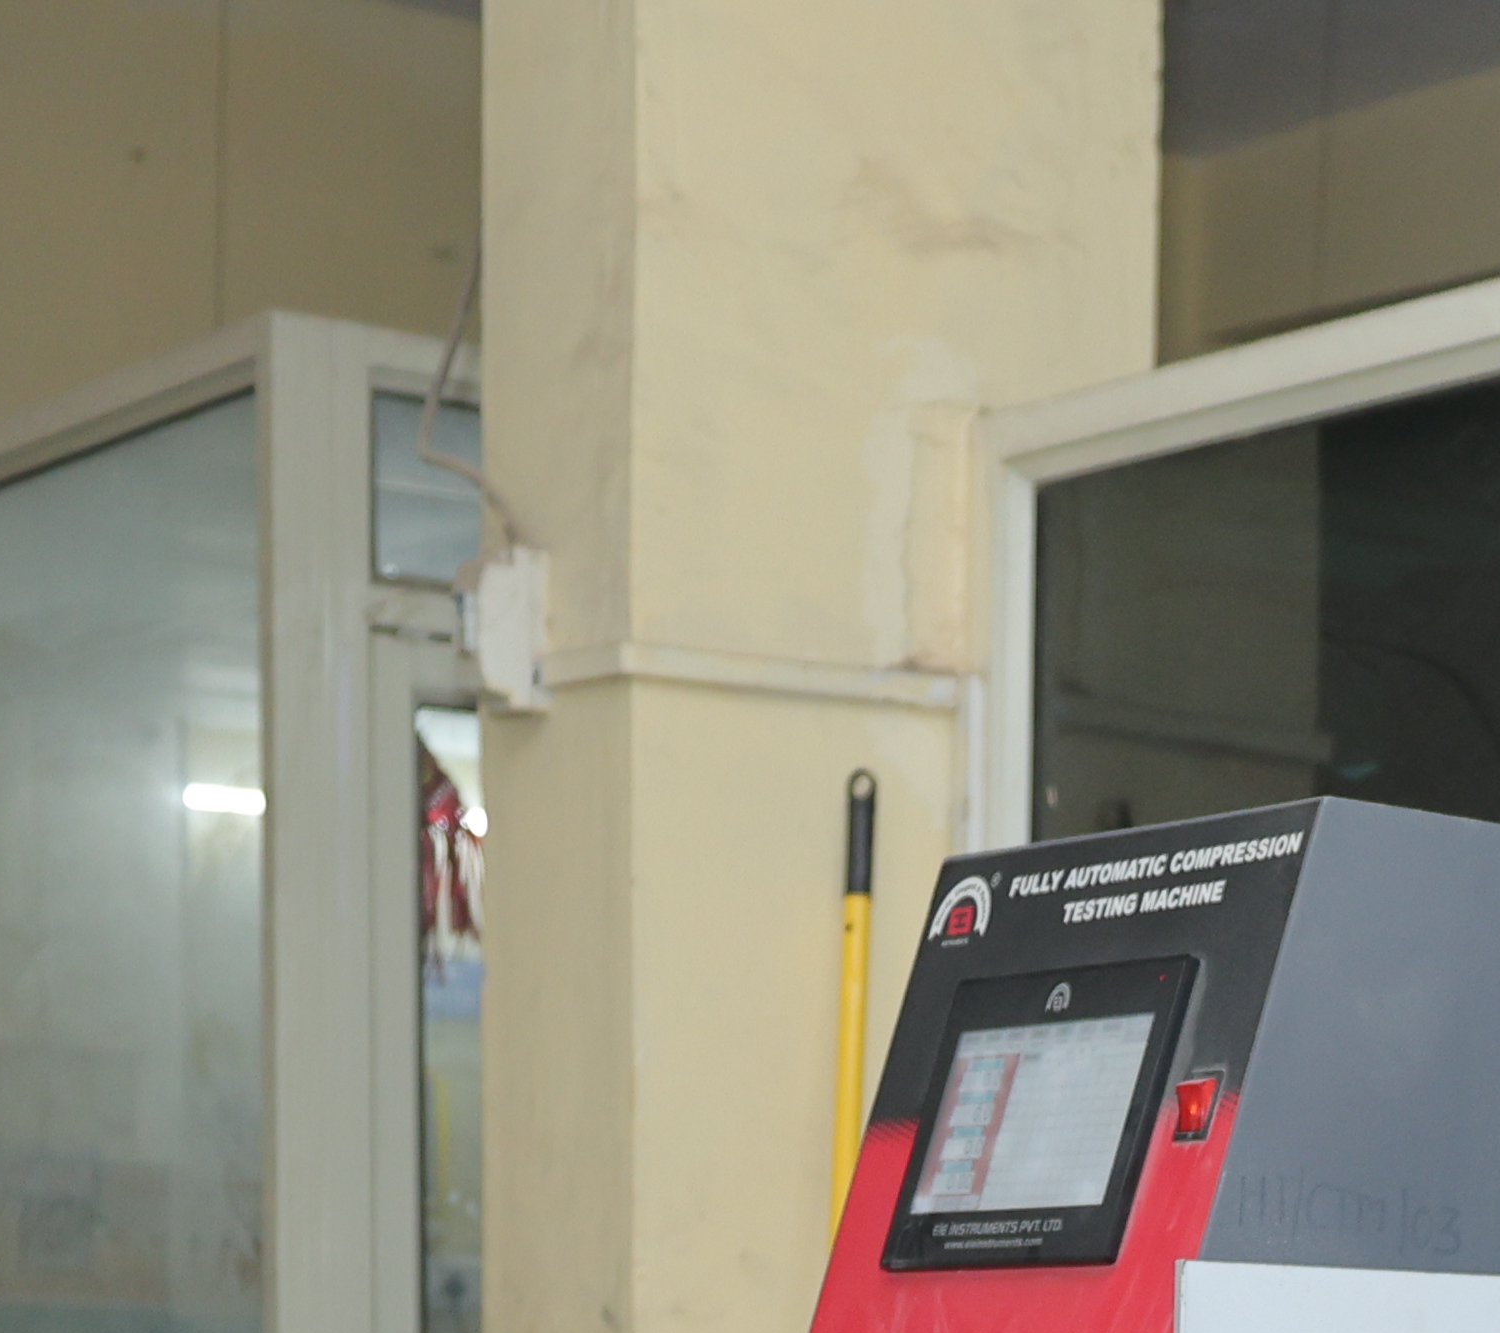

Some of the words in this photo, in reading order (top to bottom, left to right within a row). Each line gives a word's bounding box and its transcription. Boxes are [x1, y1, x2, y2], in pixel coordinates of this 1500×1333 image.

[1009, 869, 1064, 898] FULLY
[1063, 854, 1169, 890] AUTOMATIC
[1170, 831, 1304, 873] COMPRESSION
[1063, 892, 1137, 924] TESTING
[1140, 880, 1227, 914] MACHINE
[932, 1223, 947, 1237] EIE
[948, 1220, 1018, 1236] INSTRUMENTS
